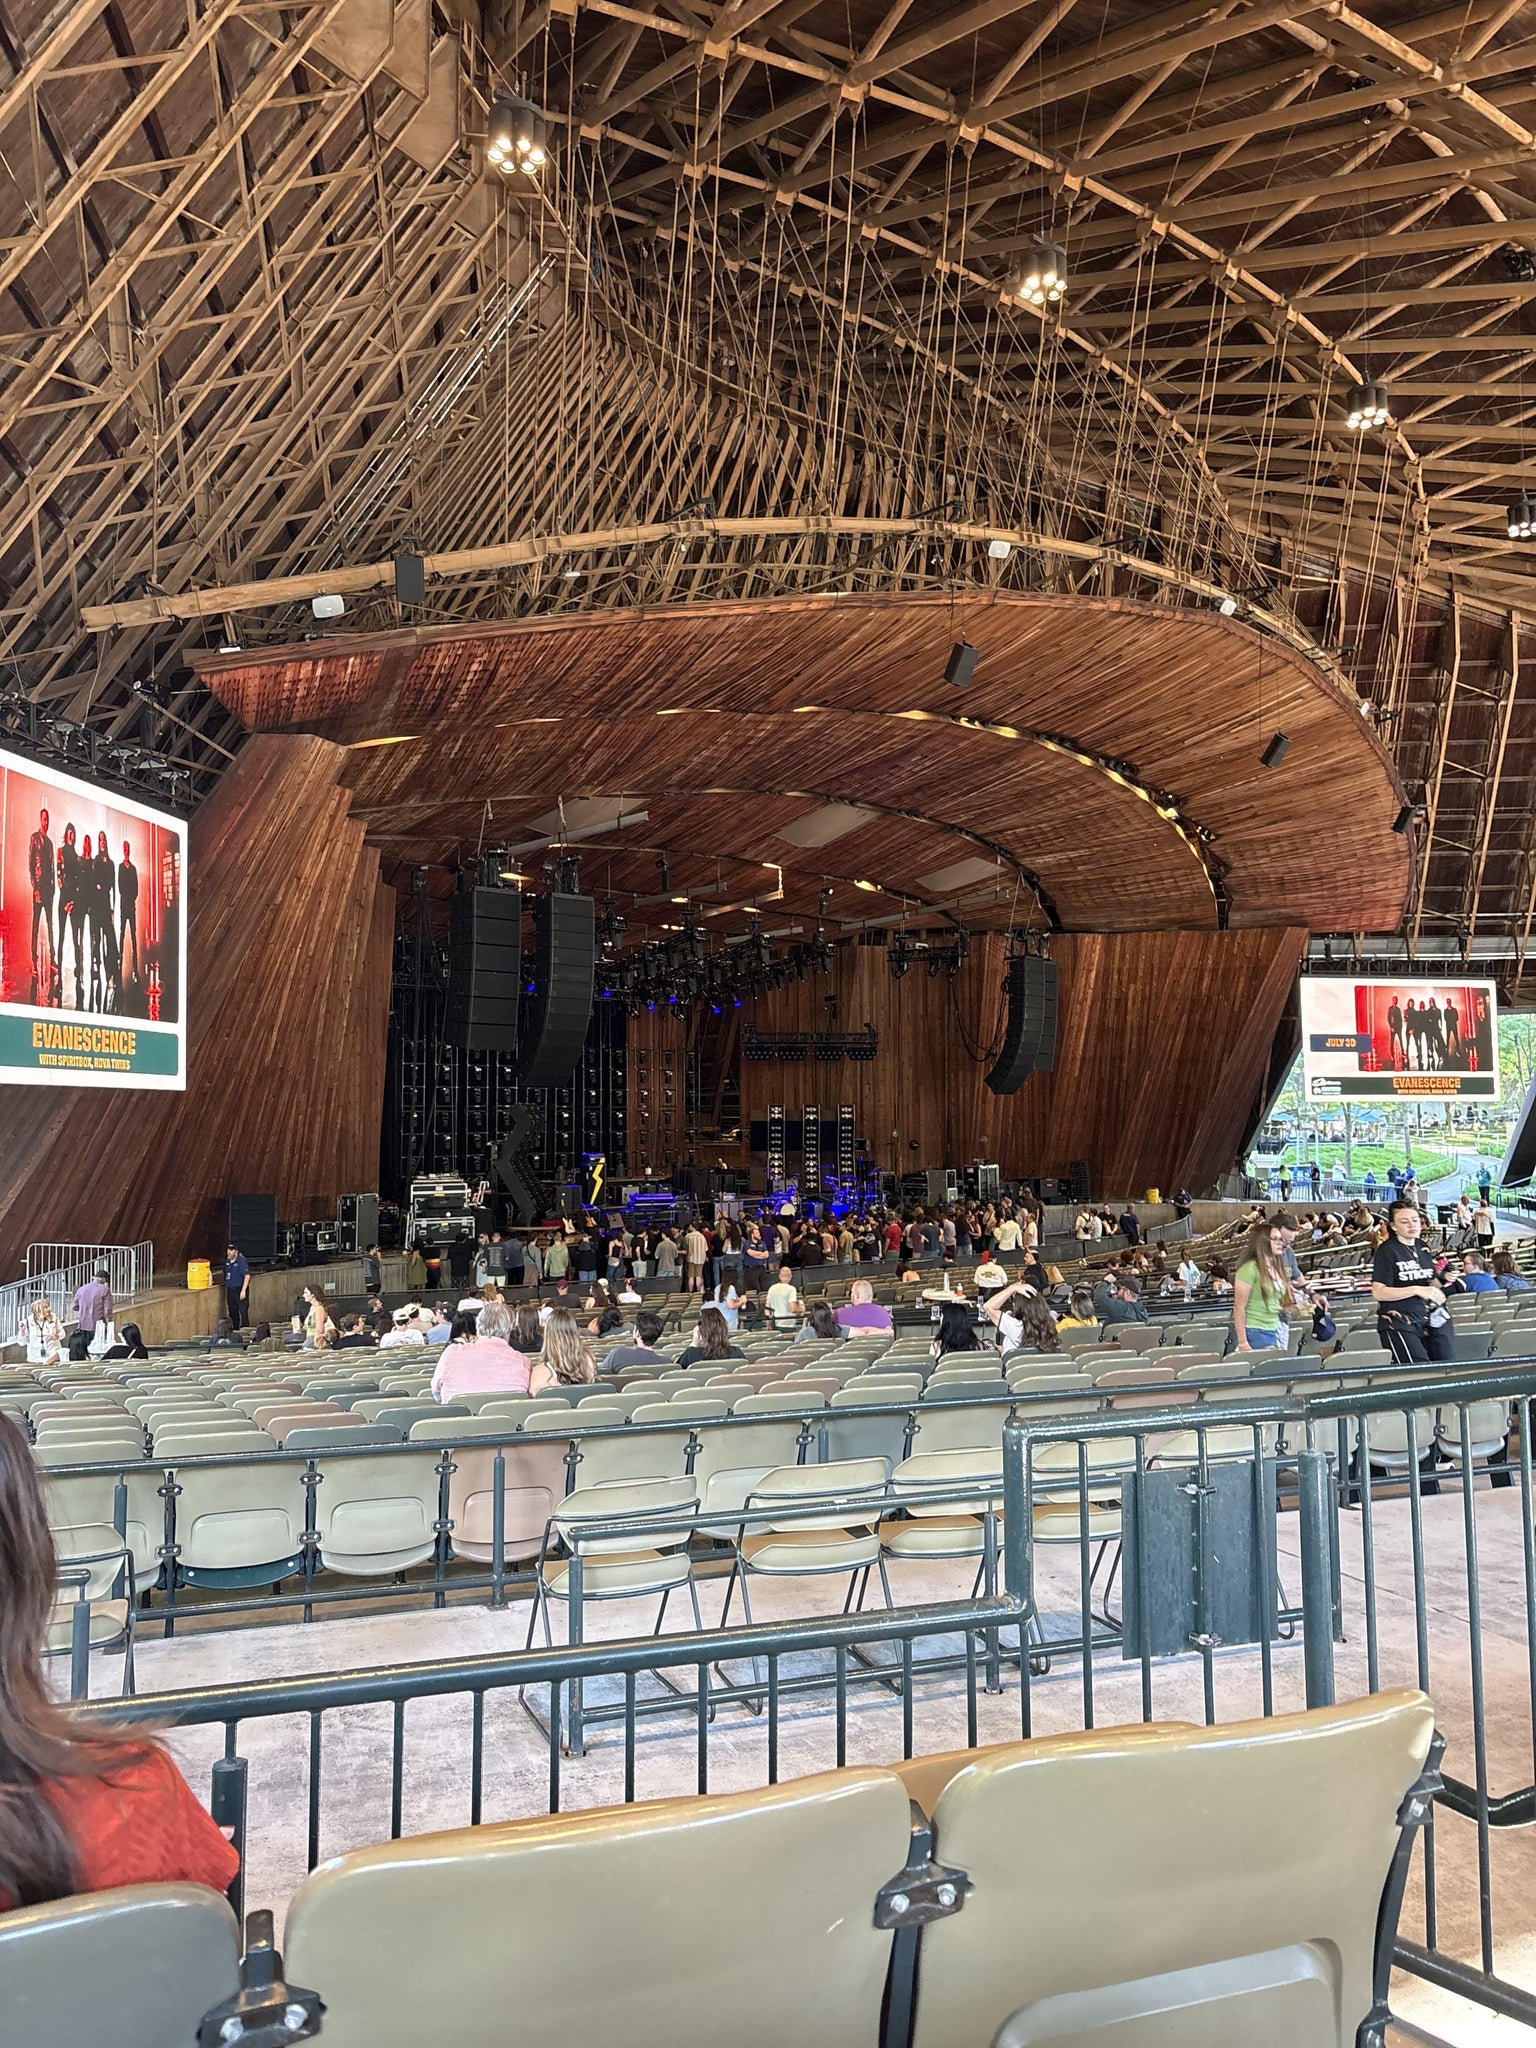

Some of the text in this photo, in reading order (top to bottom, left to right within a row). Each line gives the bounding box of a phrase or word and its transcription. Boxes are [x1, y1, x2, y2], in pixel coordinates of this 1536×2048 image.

[33, 1022, 136, 1055] EVANESCENCE
[1325, 1038, 1357, 1048] JULY 30
[39, 1053, 57, 1066] WITH
[111, 1058, 131, 1071] TWINS
[1392, 1077, 1461, 1089] EVANESCENCE
